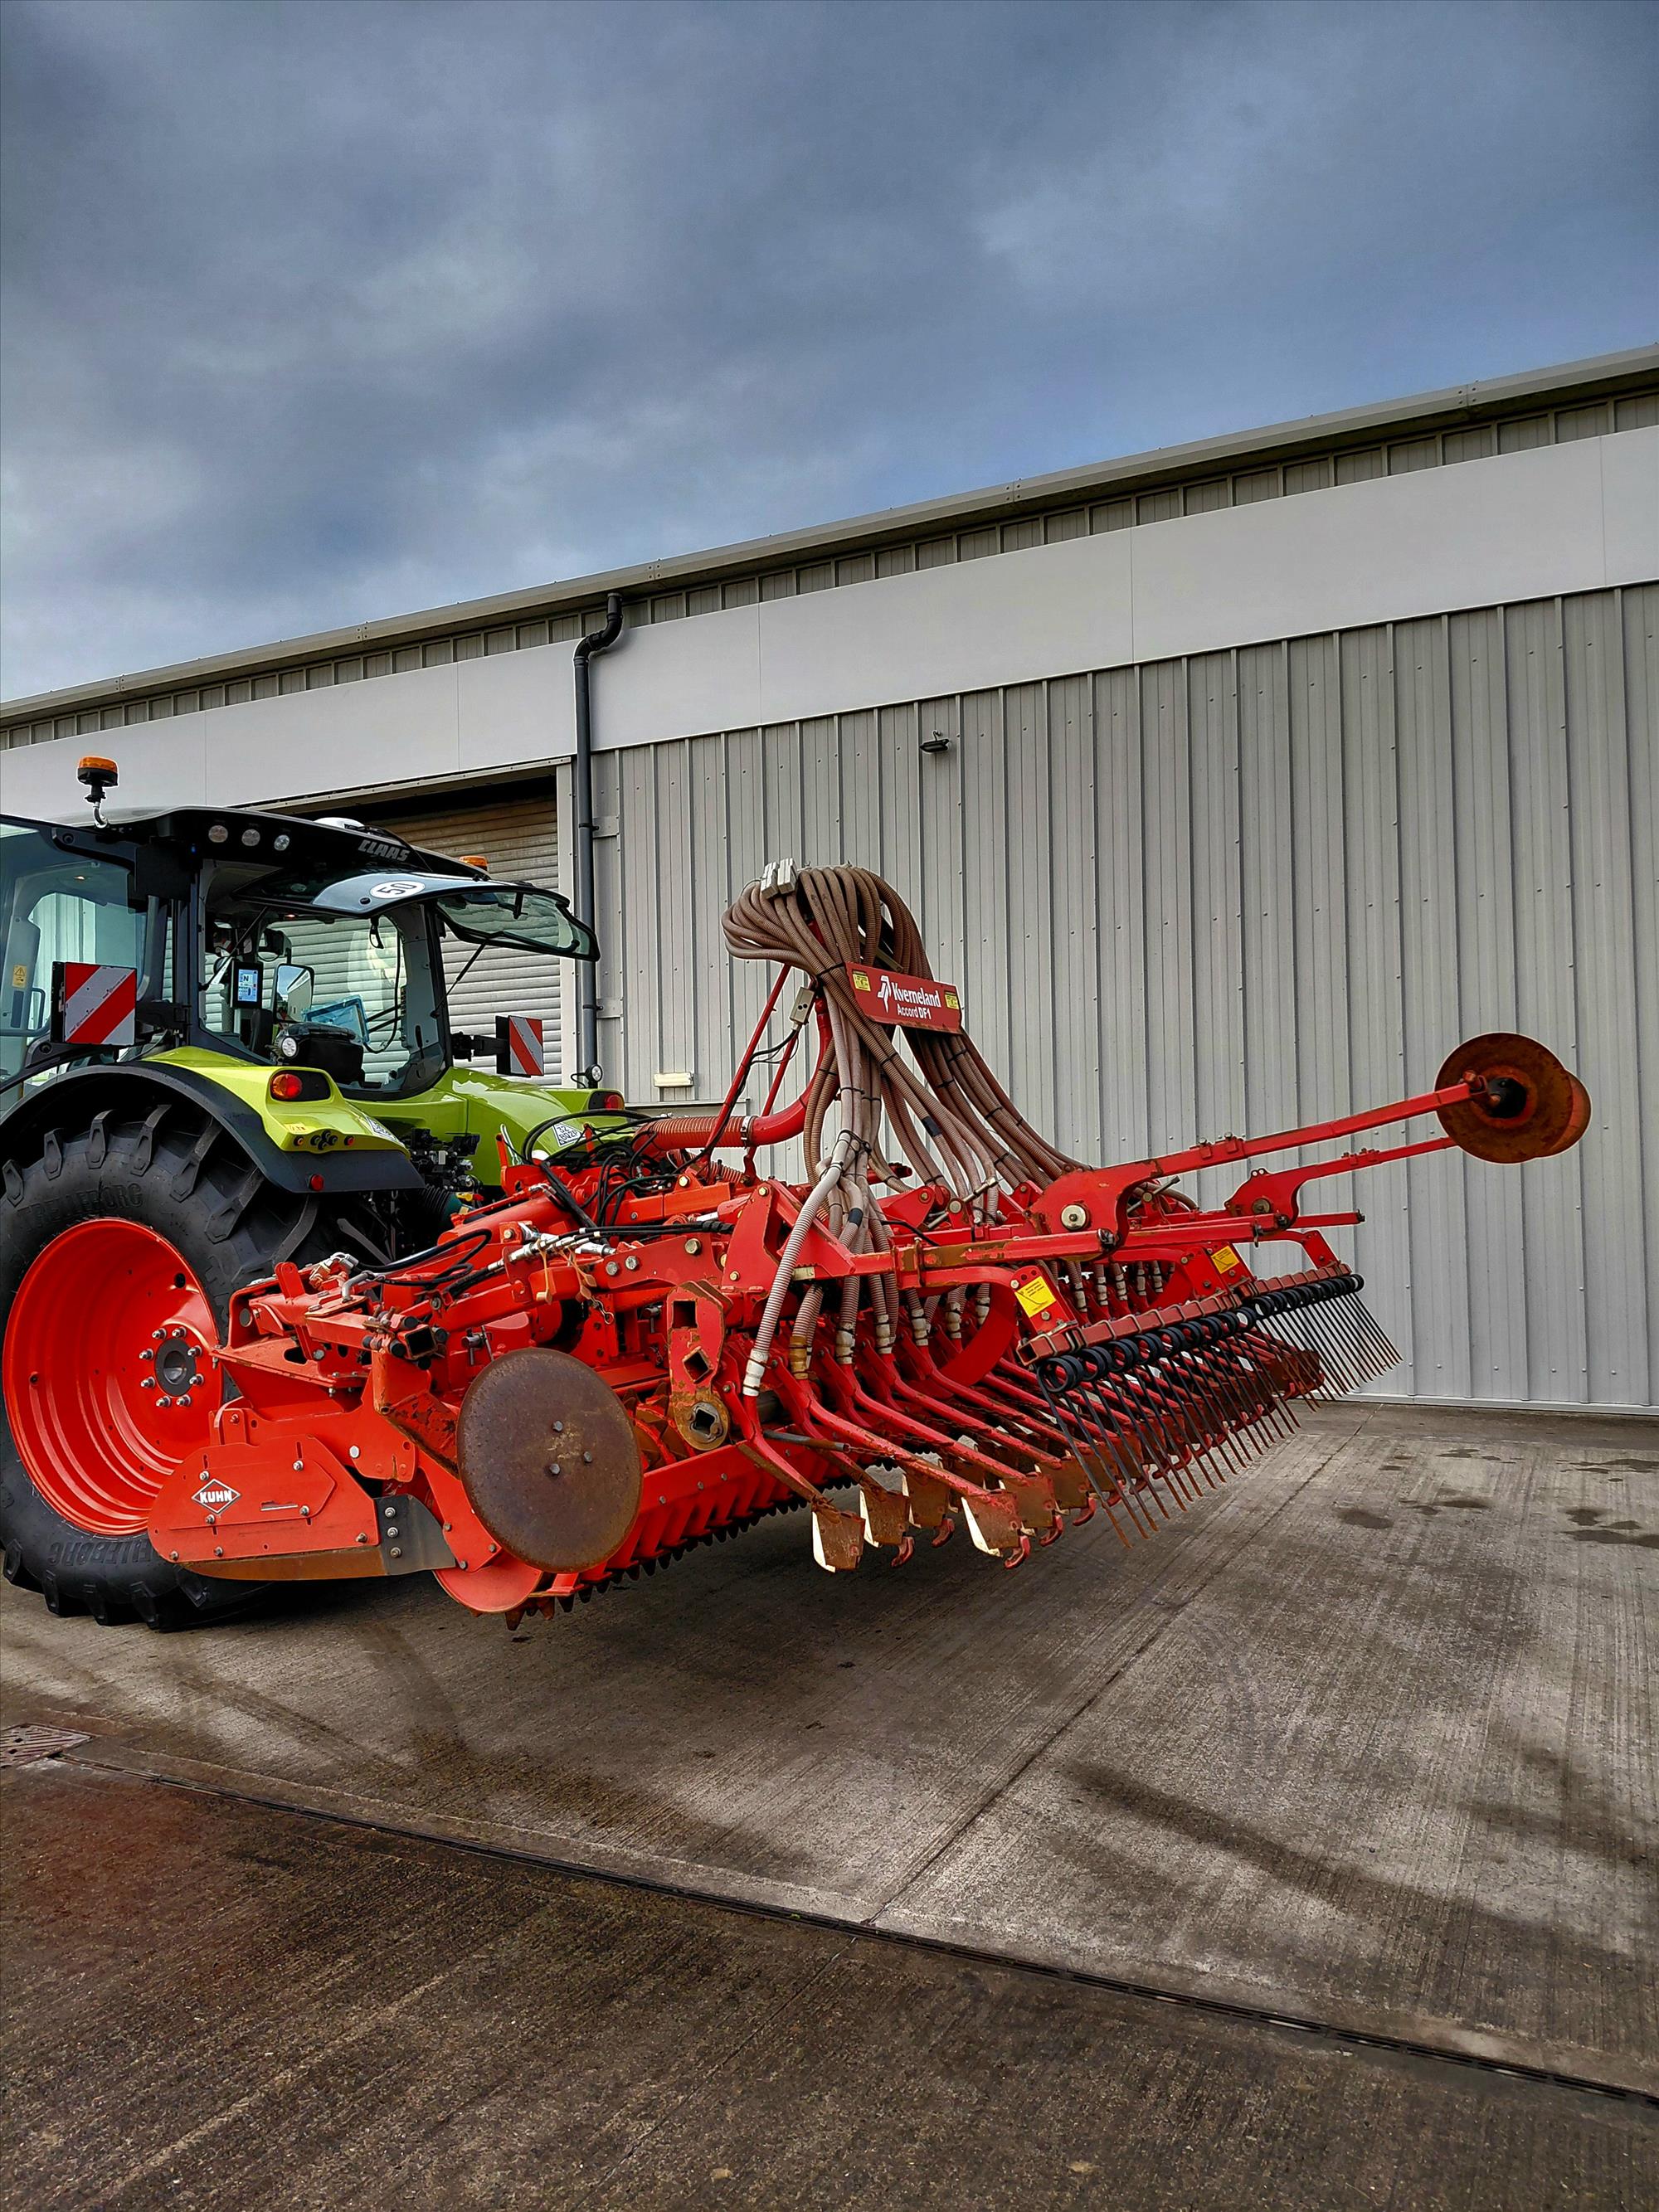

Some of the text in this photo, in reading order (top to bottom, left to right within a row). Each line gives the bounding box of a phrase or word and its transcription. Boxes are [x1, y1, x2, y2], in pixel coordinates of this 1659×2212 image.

[358, 839, 411, 862] CLAAS
[377, 882, 417, 895] 50
[891, 982, 941, 1008] Kverneland
[897, 1003, 919, 1018] Accord
[199, 1490, 233, 1504] KUHN
